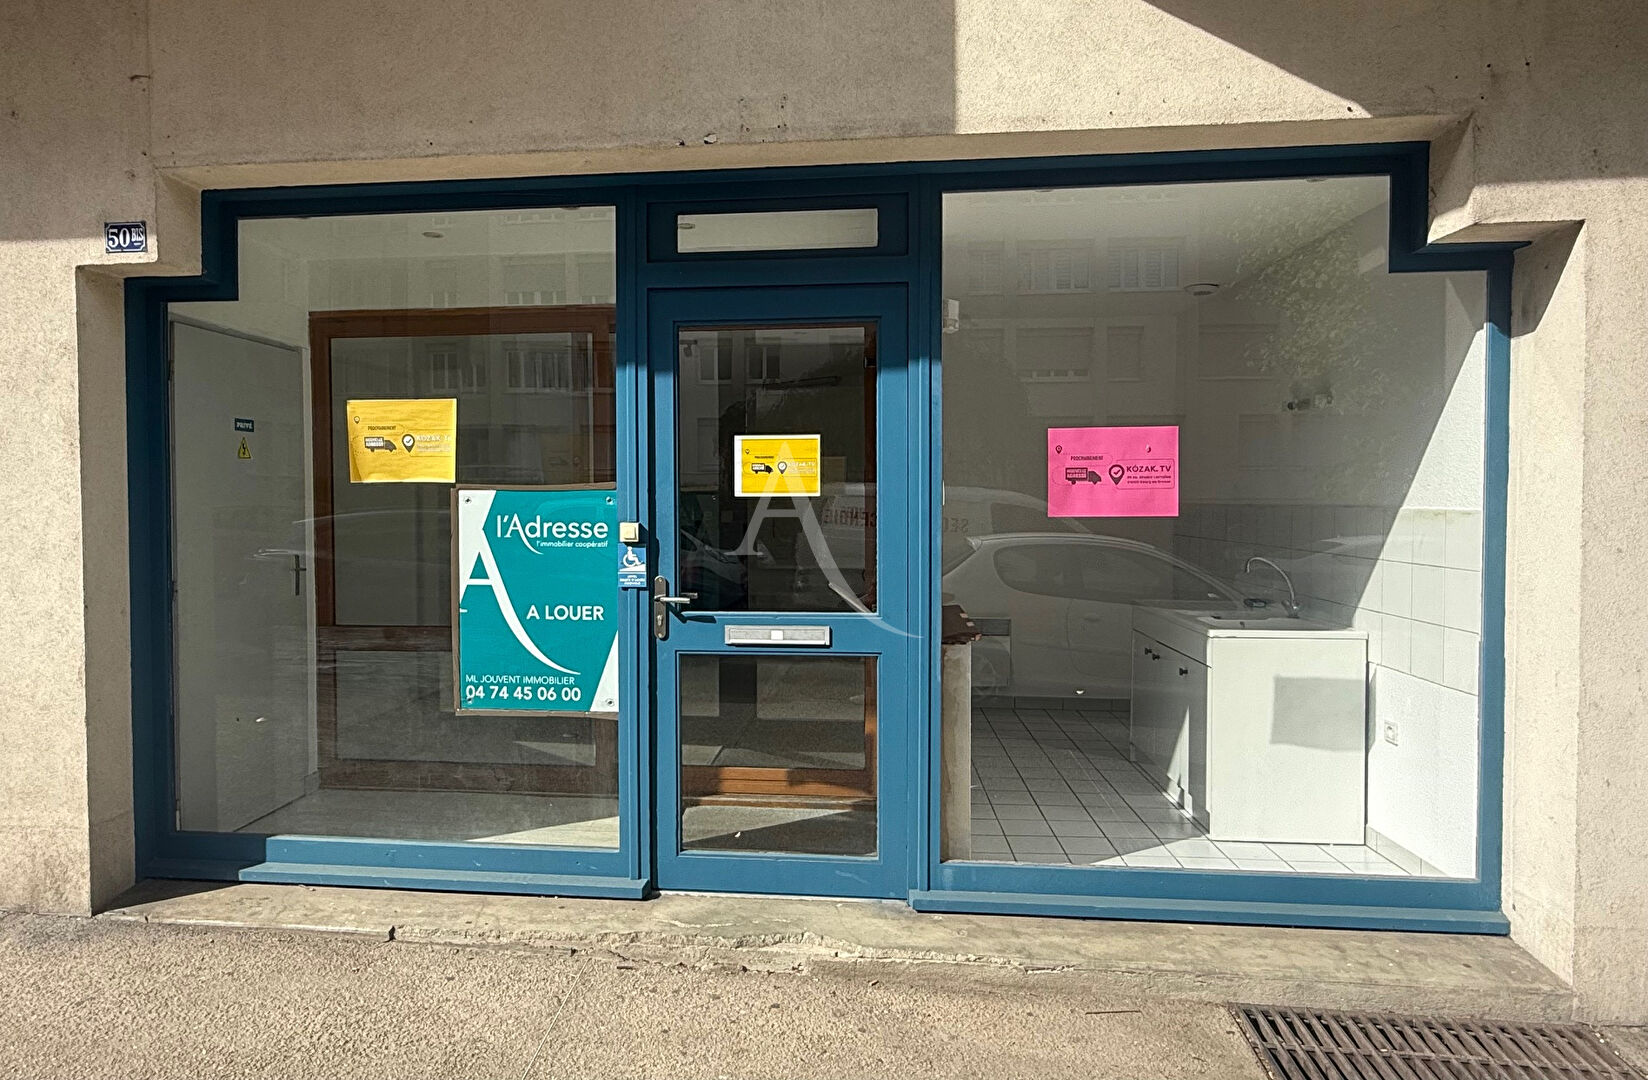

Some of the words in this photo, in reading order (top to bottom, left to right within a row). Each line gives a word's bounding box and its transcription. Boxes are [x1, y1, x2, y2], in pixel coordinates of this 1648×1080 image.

[108, 228, 130, 248] 50
[131, 227, 144, 241] BIS
[497, 513, 609, 554] l'Adresse
[526, 605, 540, 620] A
[545, 605, 604, 621] LOUER
[465, 674, 478, 683] ML
[480, 675, 520, 684] JOUVENT
[523, 676, 575, 685] IMMOBILIER
[465, 685, 485, 699] 04
[490, 686, 509, 699] 74
[513, 686, 532, 700] 45
[537, 687, 557, 701] 06
[561, 687, 581, 701] 00
